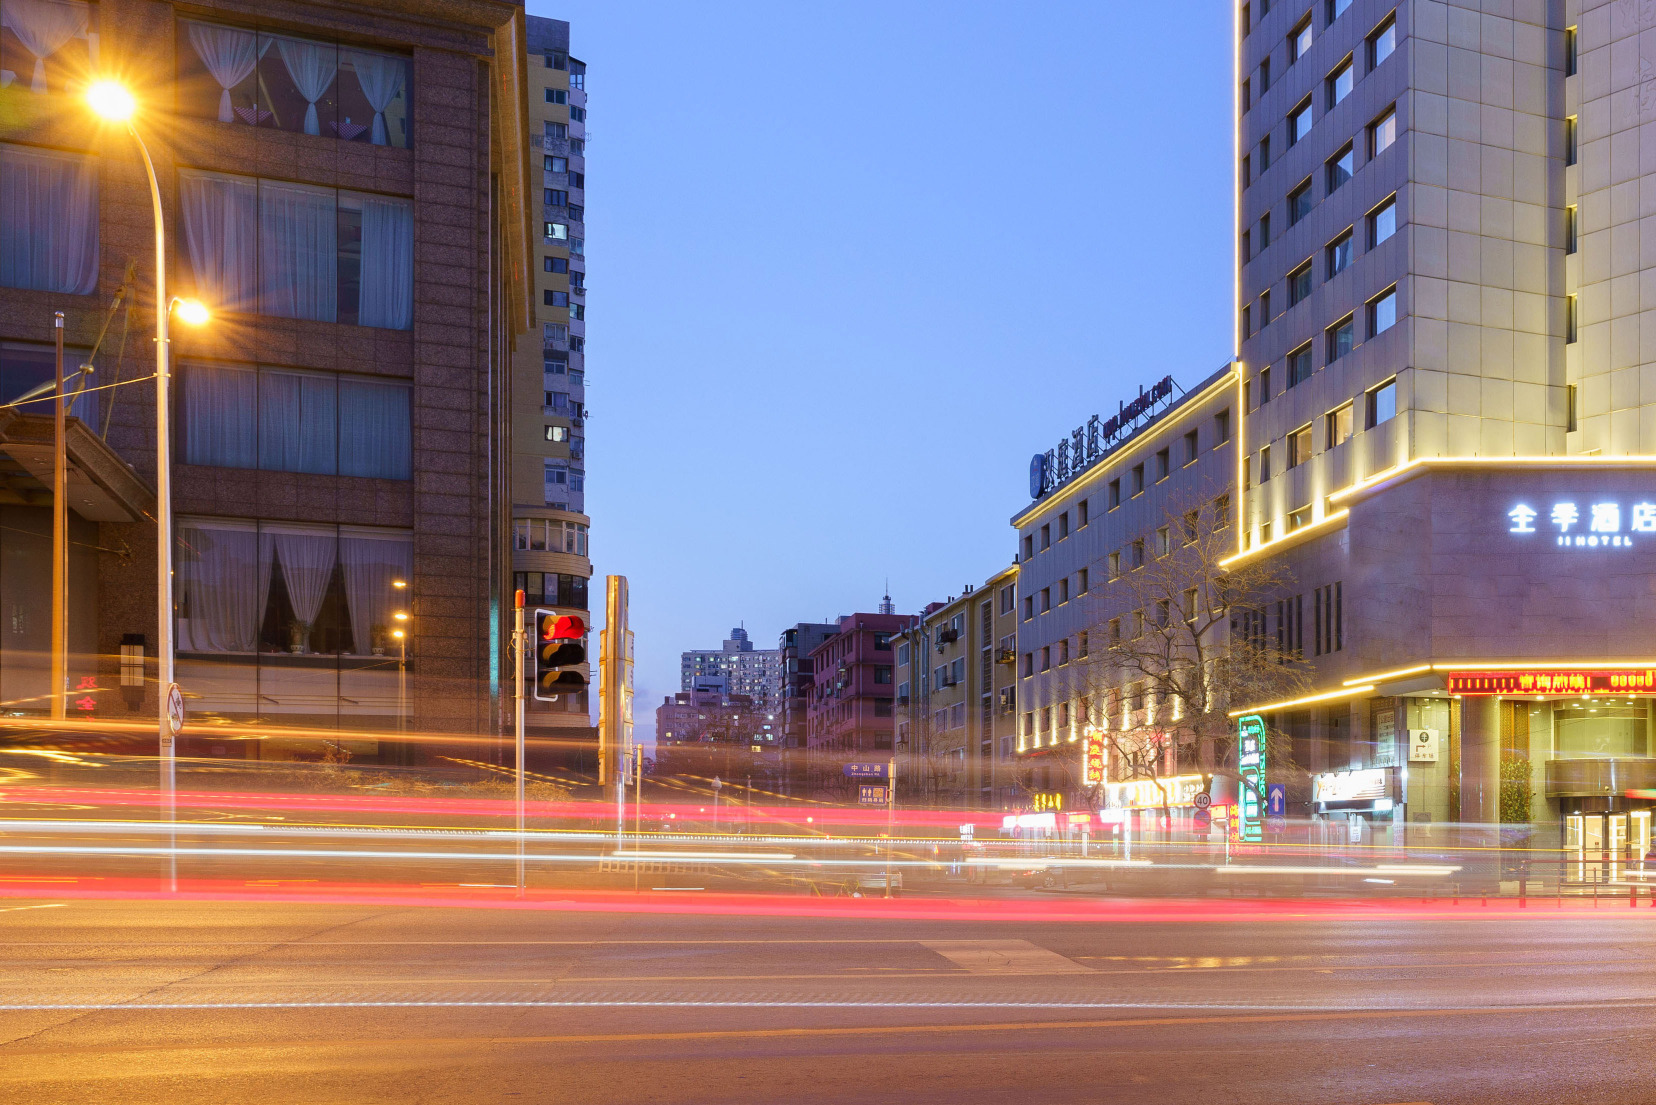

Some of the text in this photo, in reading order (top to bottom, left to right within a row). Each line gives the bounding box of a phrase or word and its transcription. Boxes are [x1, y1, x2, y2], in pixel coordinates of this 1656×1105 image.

[1576, 536, 1632, 546] HOTEL
[851, 764, 881, 772] 中山路
[1197, 796, 1208, 805] 40
